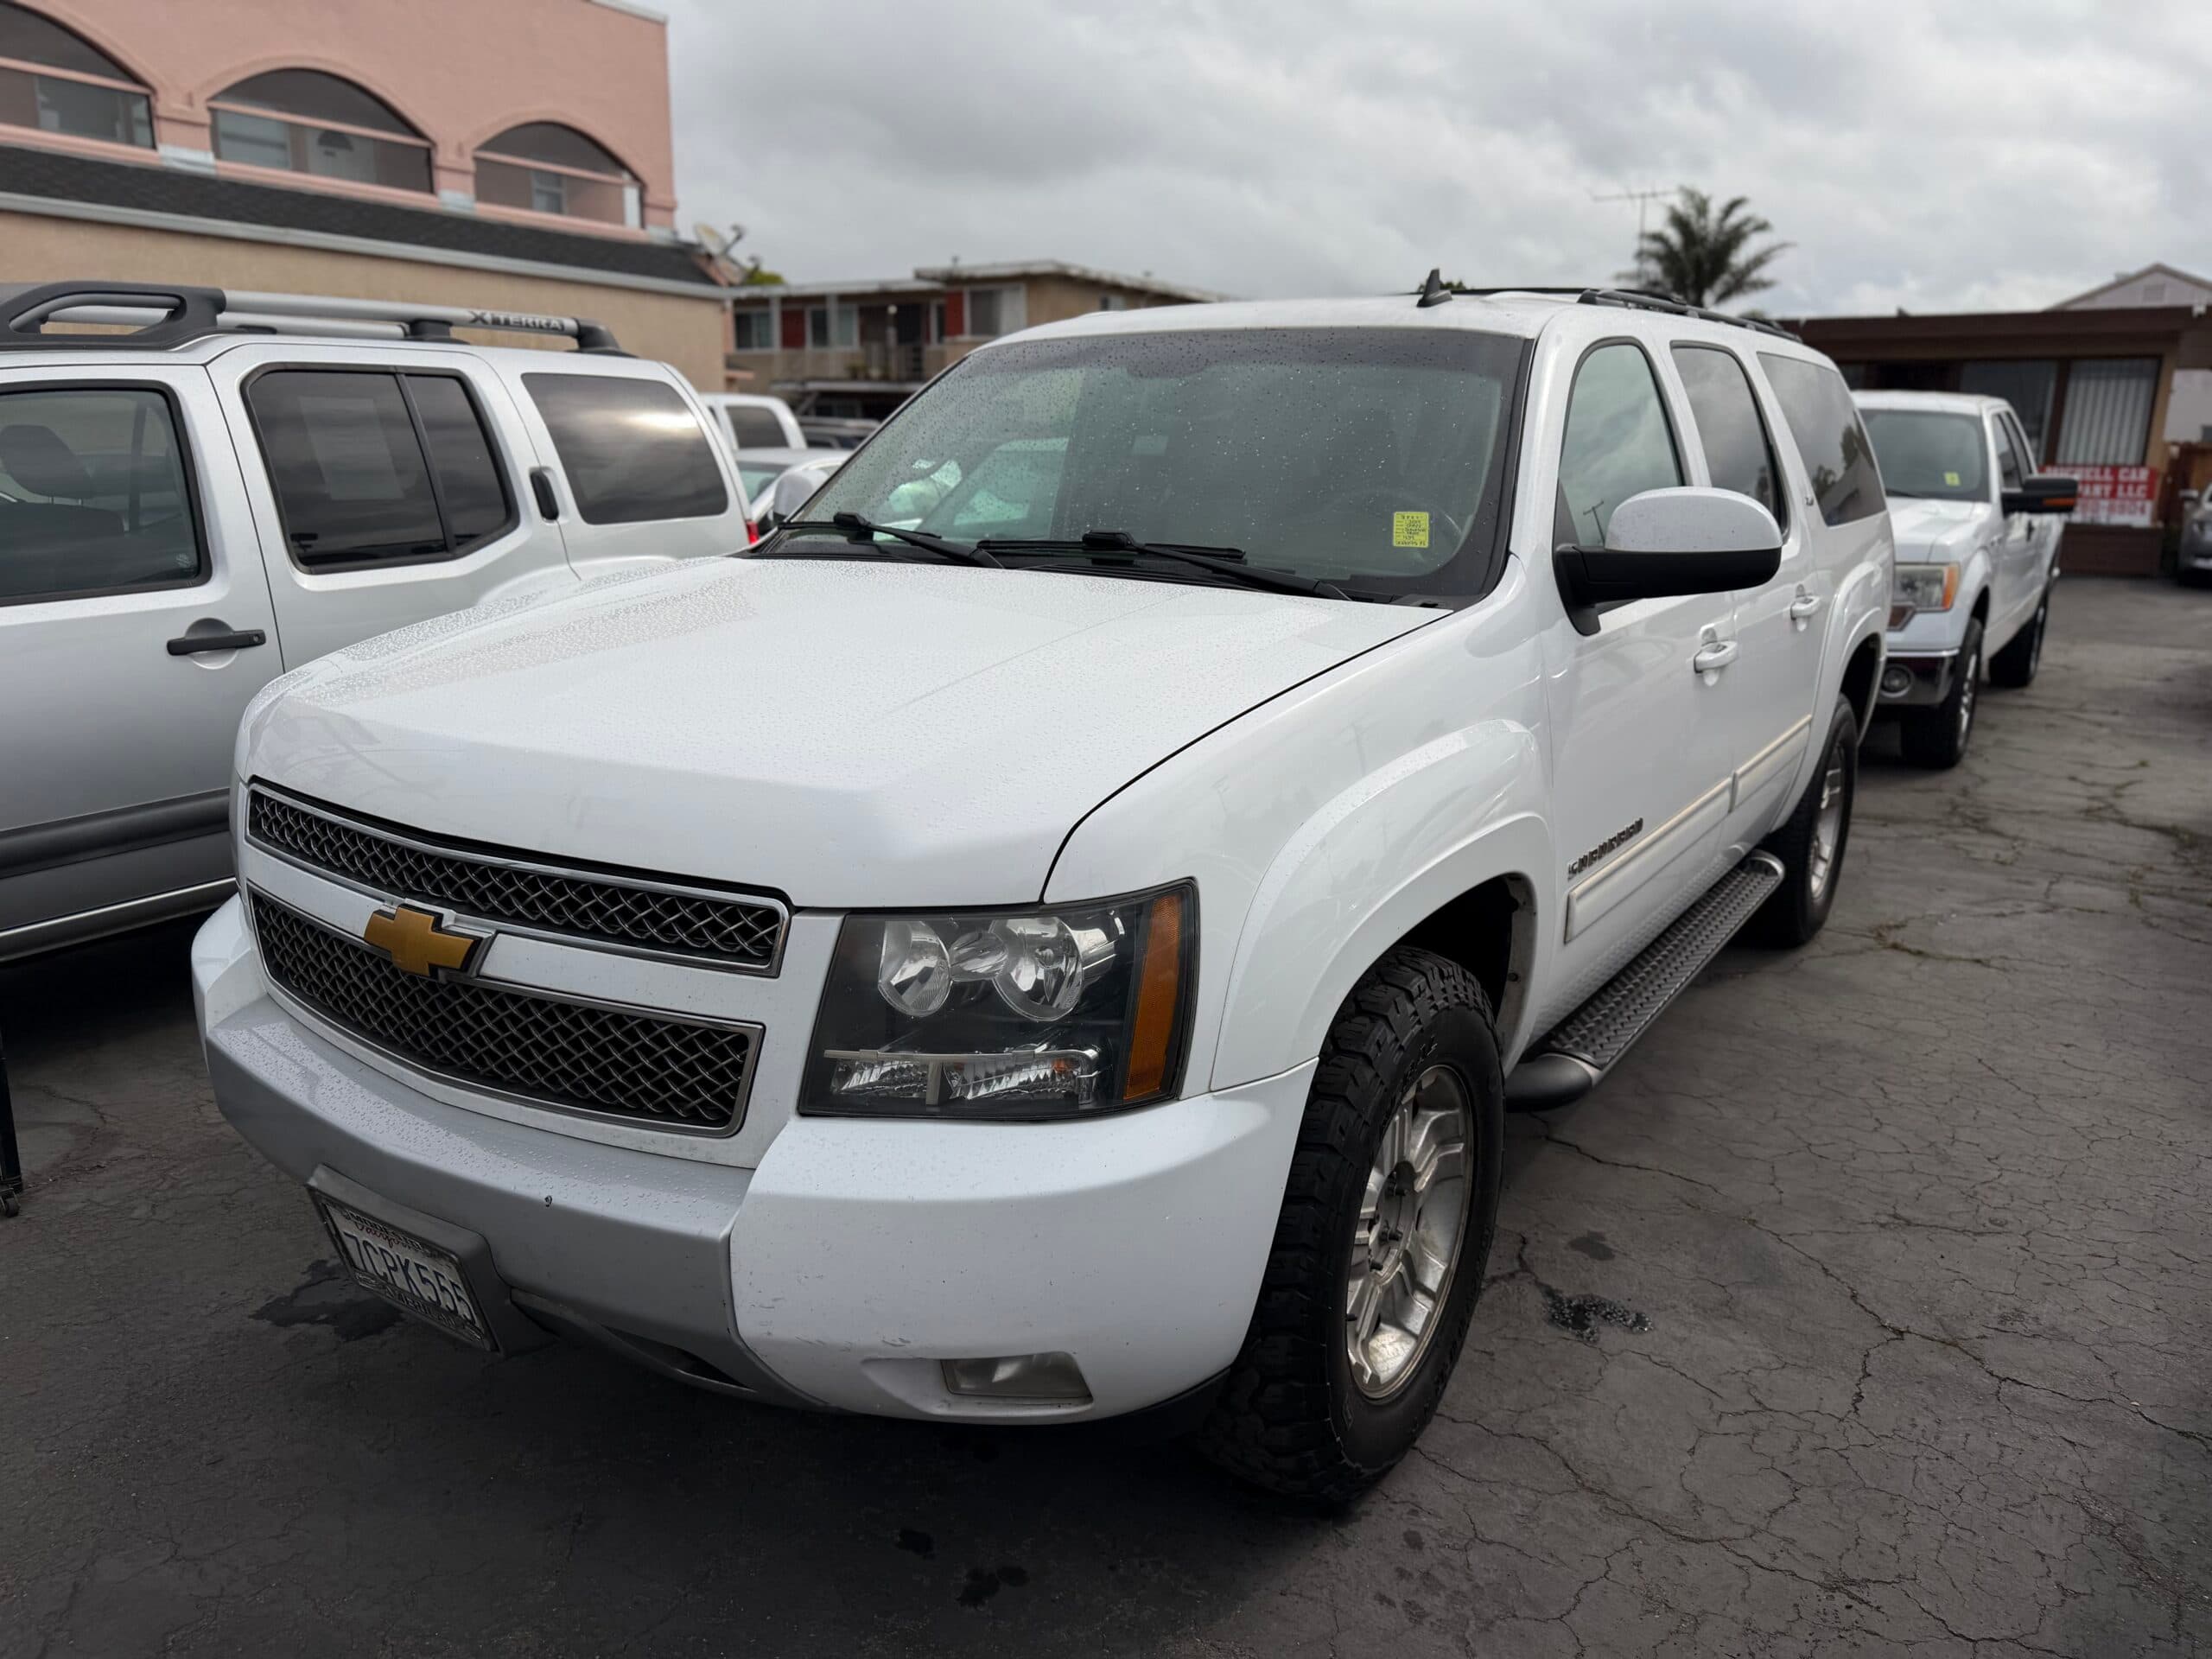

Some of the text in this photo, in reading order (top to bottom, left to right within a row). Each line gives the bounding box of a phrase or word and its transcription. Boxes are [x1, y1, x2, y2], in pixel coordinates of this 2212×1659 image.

[468, 310, 565, 332] XTERRA
[2117, 467, 2150, 481] CAR
[2117, 484, 2148, 499] LLC
[343, 1230, 476, 1328] 7CPK555
